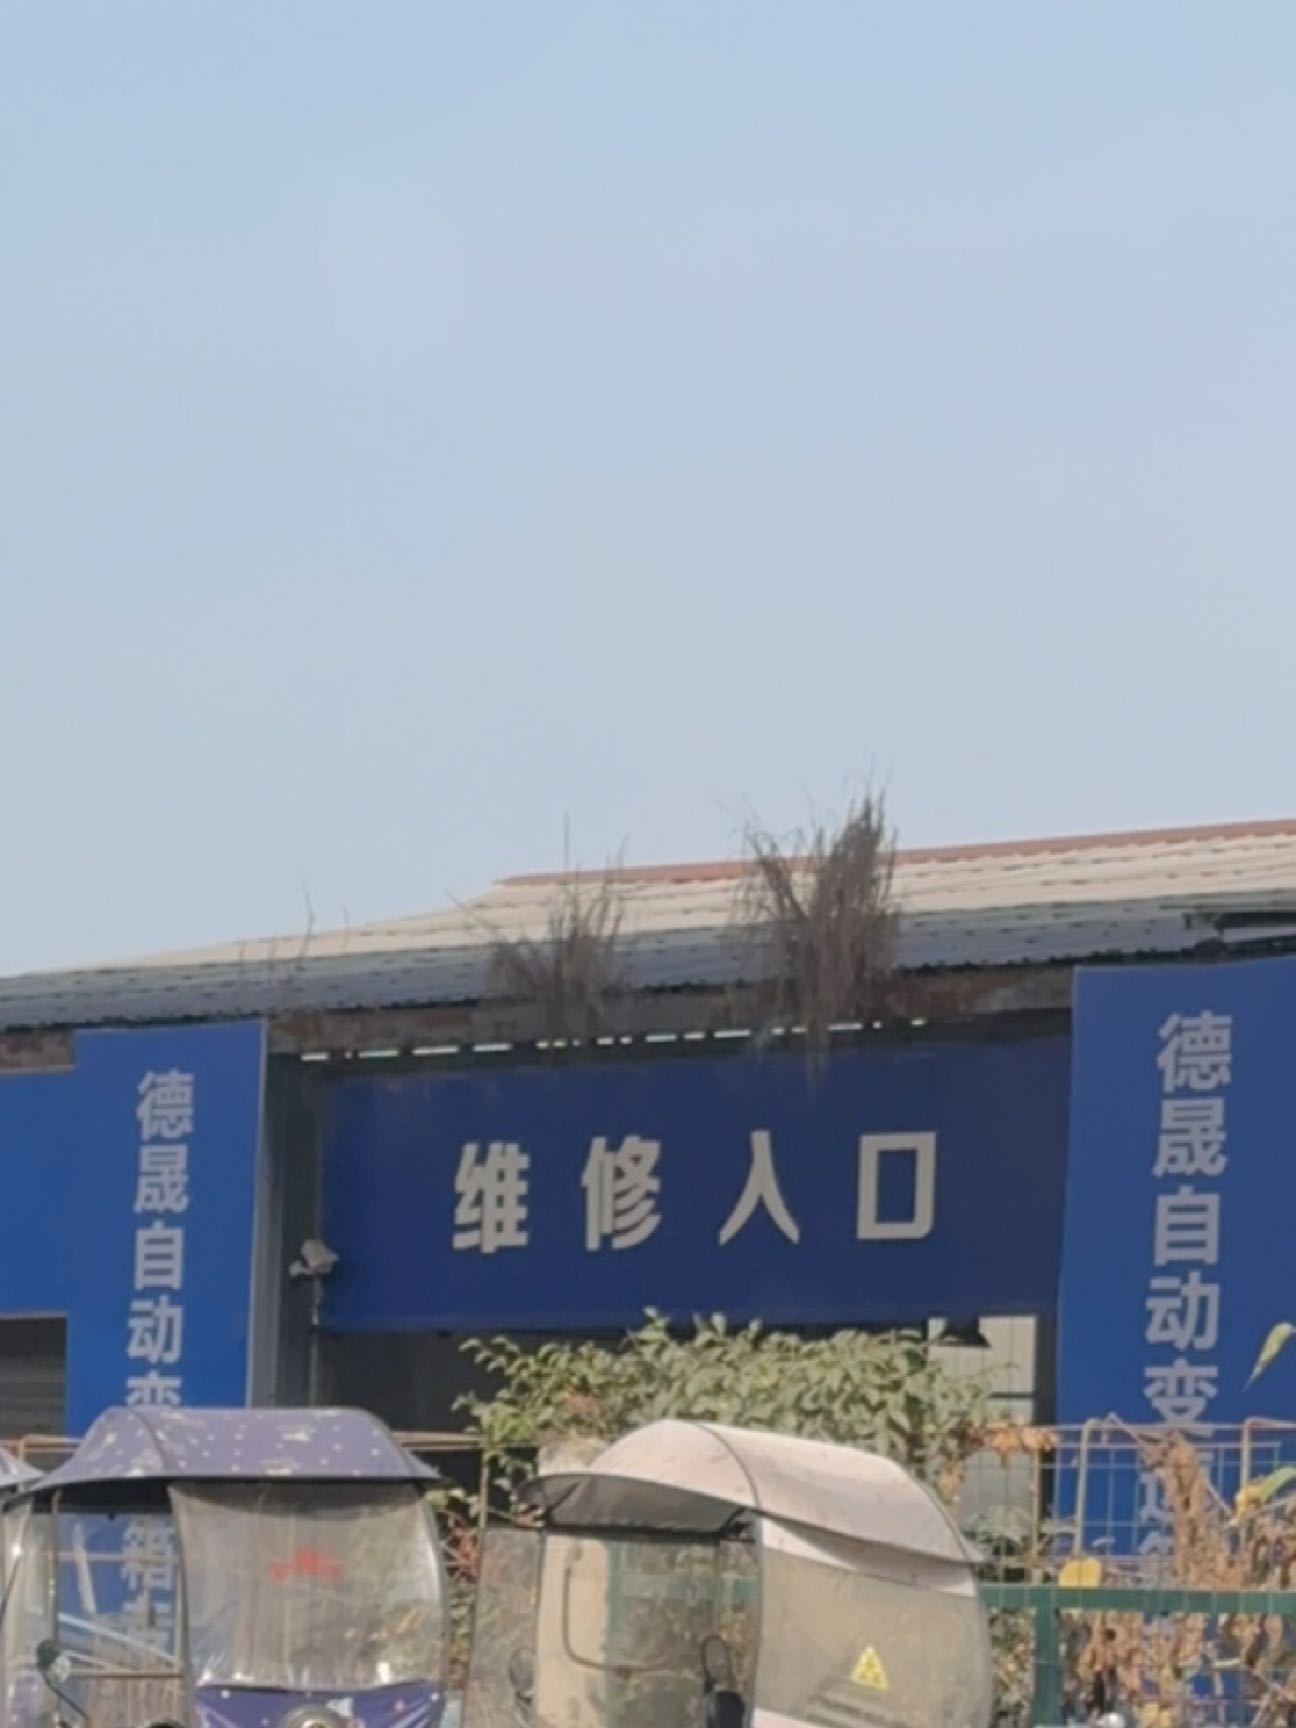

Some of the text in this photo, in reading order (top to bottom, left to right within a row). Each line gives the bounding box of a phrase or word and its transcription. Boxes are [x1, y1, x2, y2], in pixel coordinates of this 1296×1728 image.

[1144, 1010, 1232, 1515] 德晟自动变
